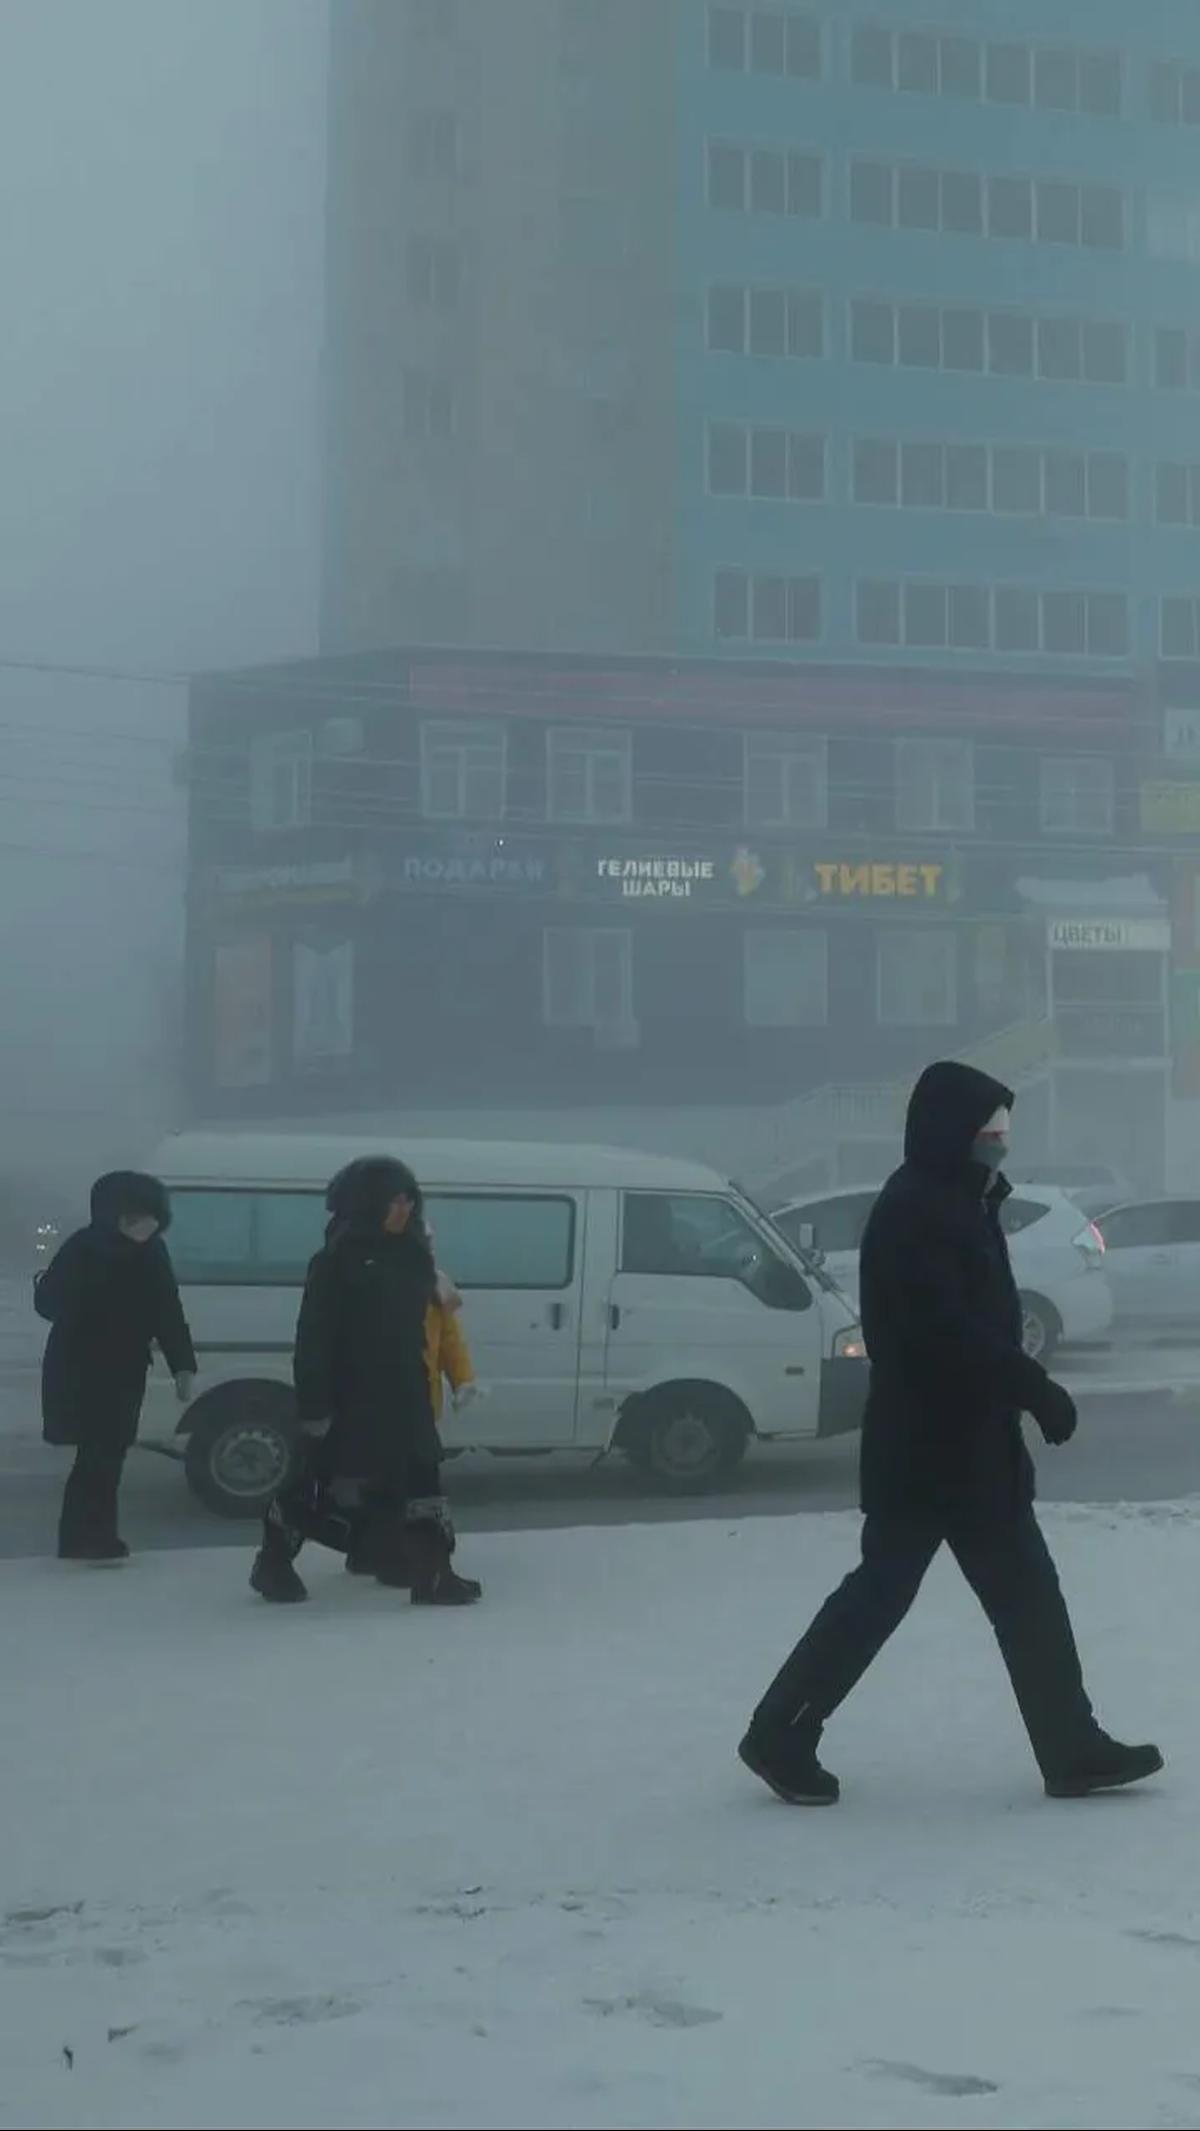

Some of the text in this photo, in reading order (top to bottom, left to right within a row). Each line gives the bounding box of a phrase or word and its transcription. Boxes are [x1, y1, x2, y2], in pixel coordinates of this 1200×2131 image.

[597, 857, 715, 879] ГЕЛИЕВЫЕ
[621, 878, 692, 898] ШАРЫ
[814, 862, 943, 898] ТИБЕТ
[1053, 923, 1123, 945] ЦВЕТЫ
